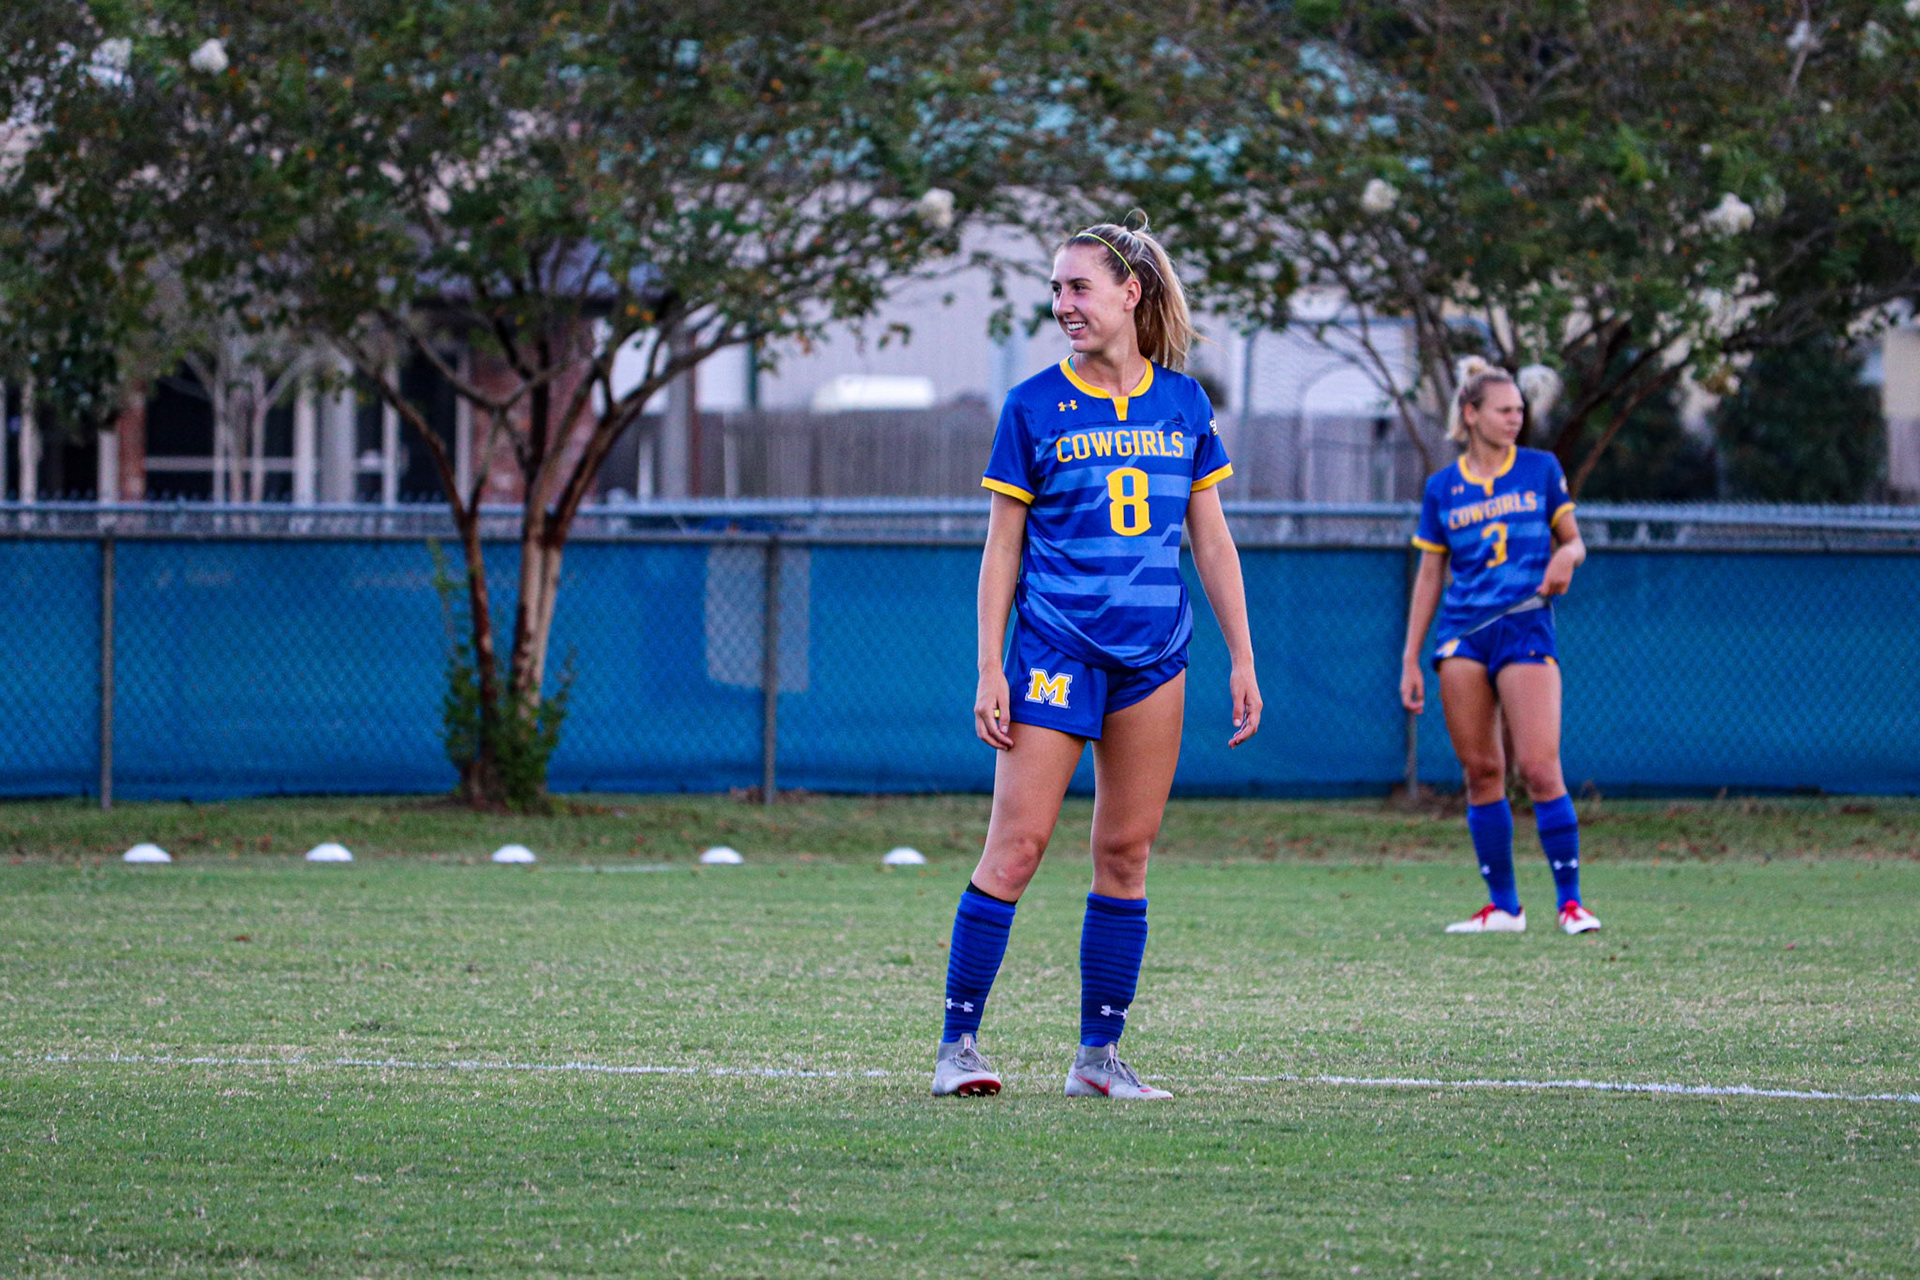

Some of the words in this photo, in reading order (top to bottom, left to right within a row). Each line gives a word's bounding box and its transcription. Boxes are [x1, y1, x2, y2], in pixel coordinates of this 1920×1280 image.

[1056, 430, 1184, 462] COWGIRLS
[1105, 467, 1152, 536] 8
[1448, 491, 1537, 530] COWGIRLS
[1481, 522, 1508, 568] 3
[1025, 668, 1073, 709] M
